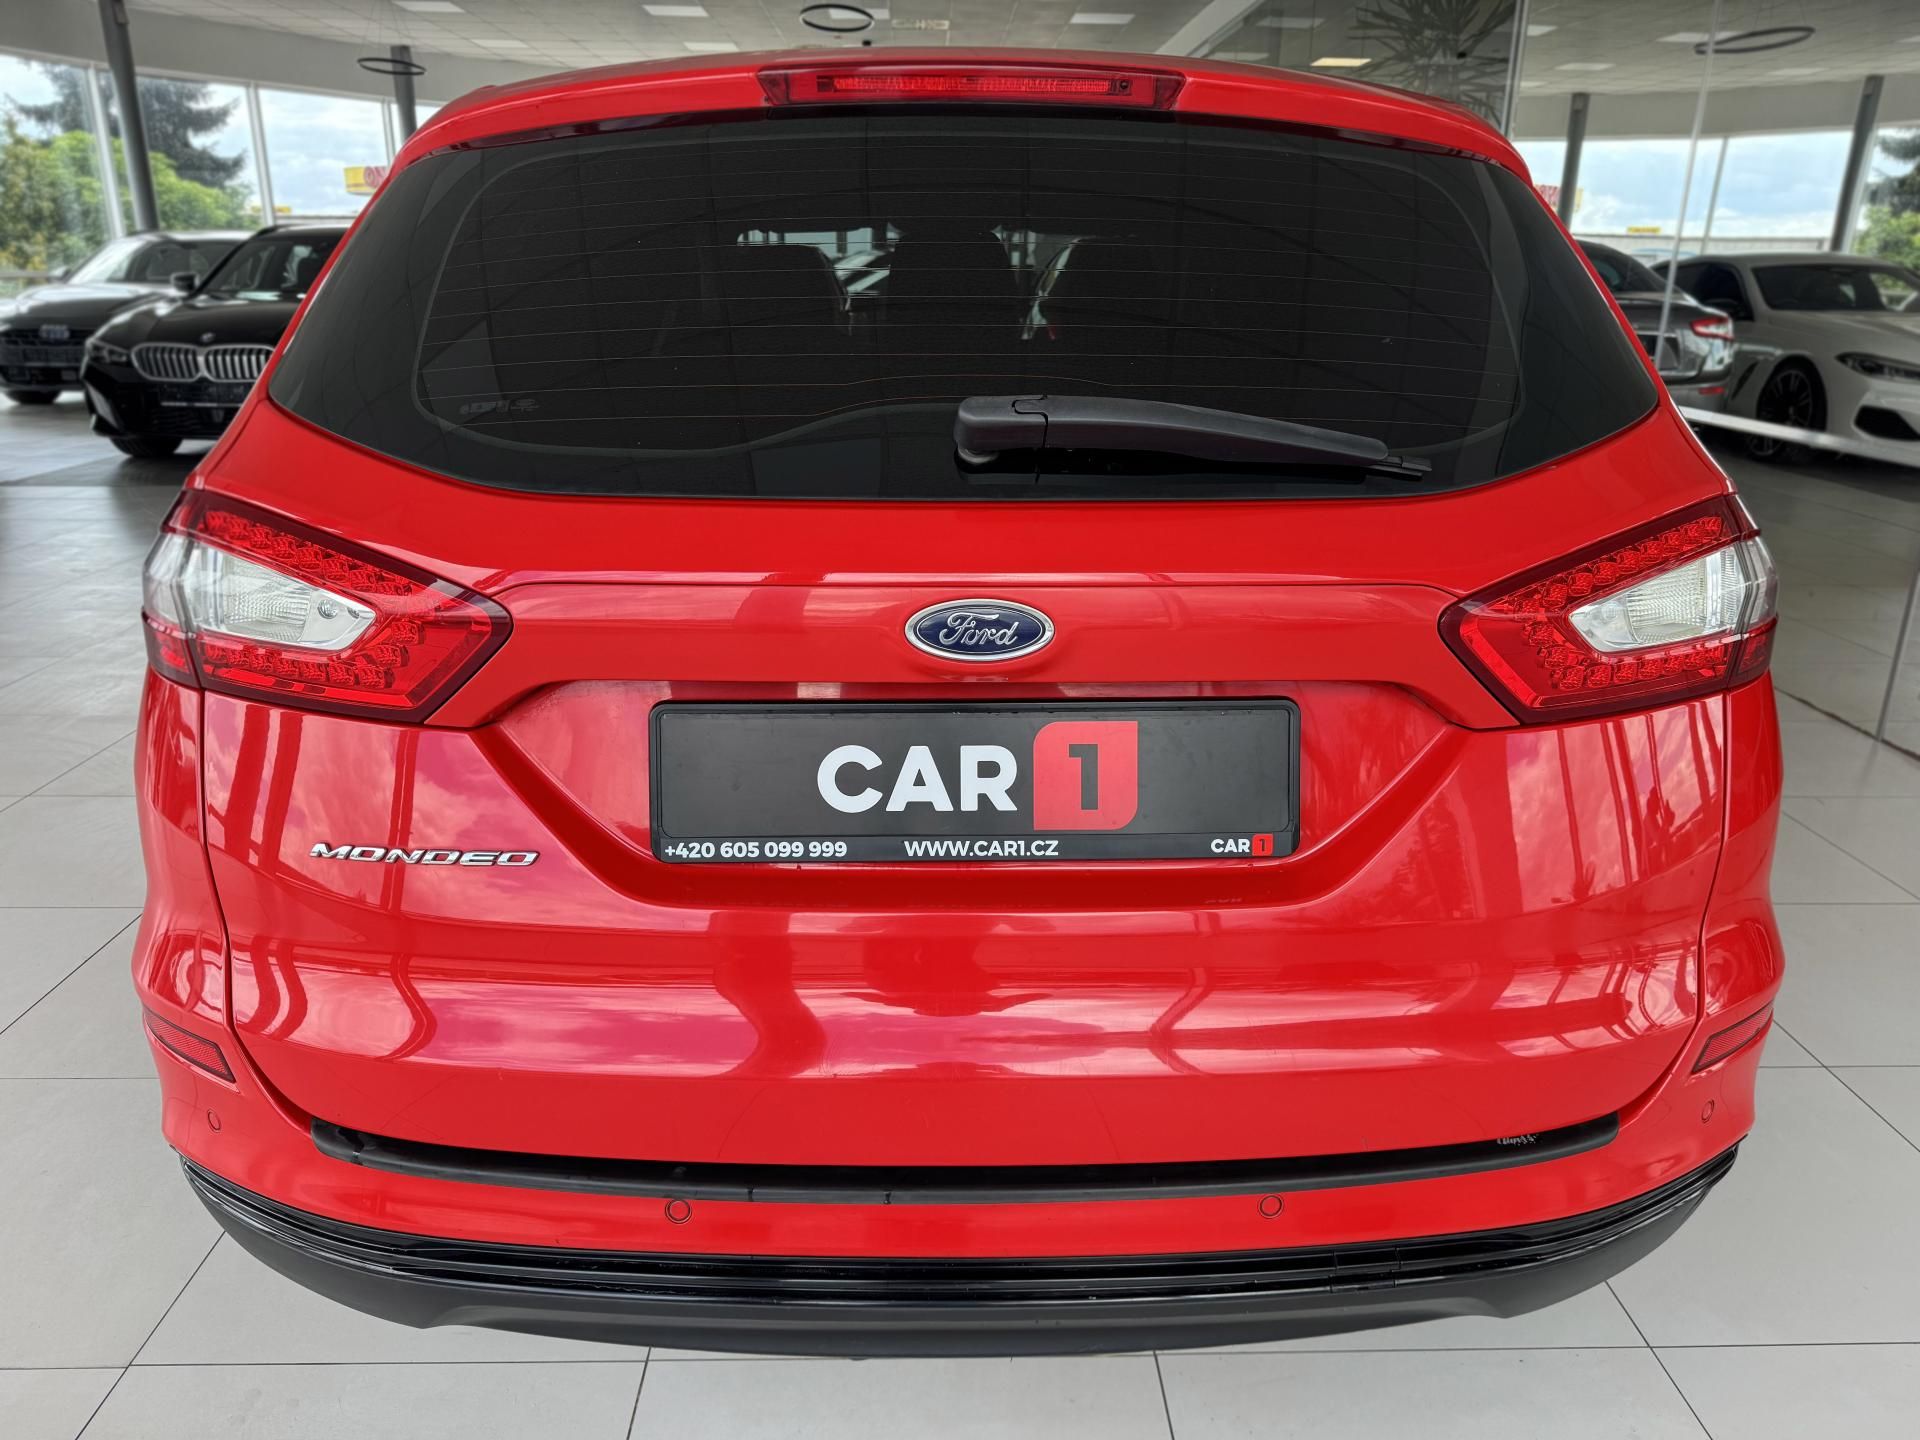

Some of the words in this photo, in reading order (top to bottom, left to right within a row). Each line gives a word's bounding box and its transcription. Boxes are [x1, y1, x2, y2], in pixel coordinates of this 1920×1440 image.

[939, 612, 1019, 645] Ford
[309, 842, 540, 866] MONDEO
[664, 842, 716, 858] +420
[719, 842, 760, 858] 605
[763, 841, 805, 858] 099
[808, 841, 848, 858] 999
[903, 840, 1059, 857] WWW.CAR1.CZ
